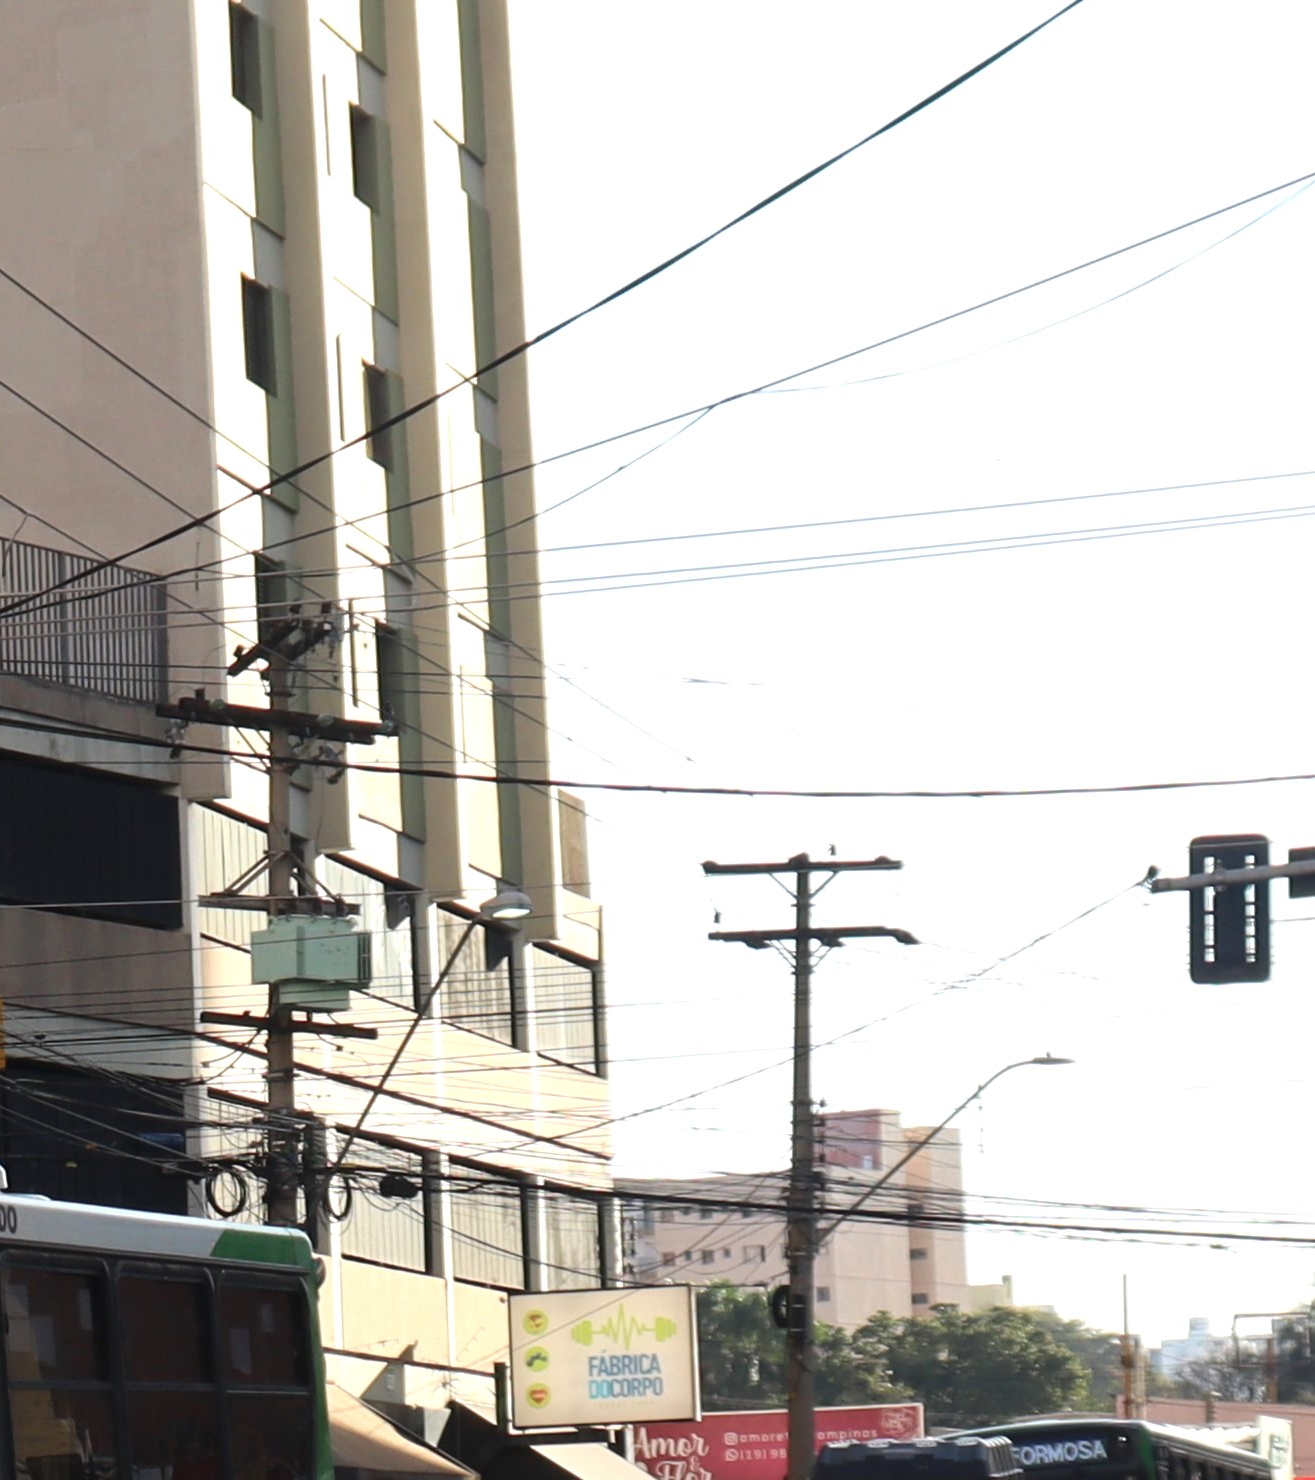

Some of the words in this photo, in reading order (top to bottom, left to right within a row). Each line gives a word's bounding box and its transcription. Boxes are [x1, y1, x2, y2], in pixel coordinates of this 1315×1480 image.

[587, 1349, 662, 1377] FÁBRICA
[634, 1427, 709, 1460] Amor
[689, 1455, 701, 1471] &
